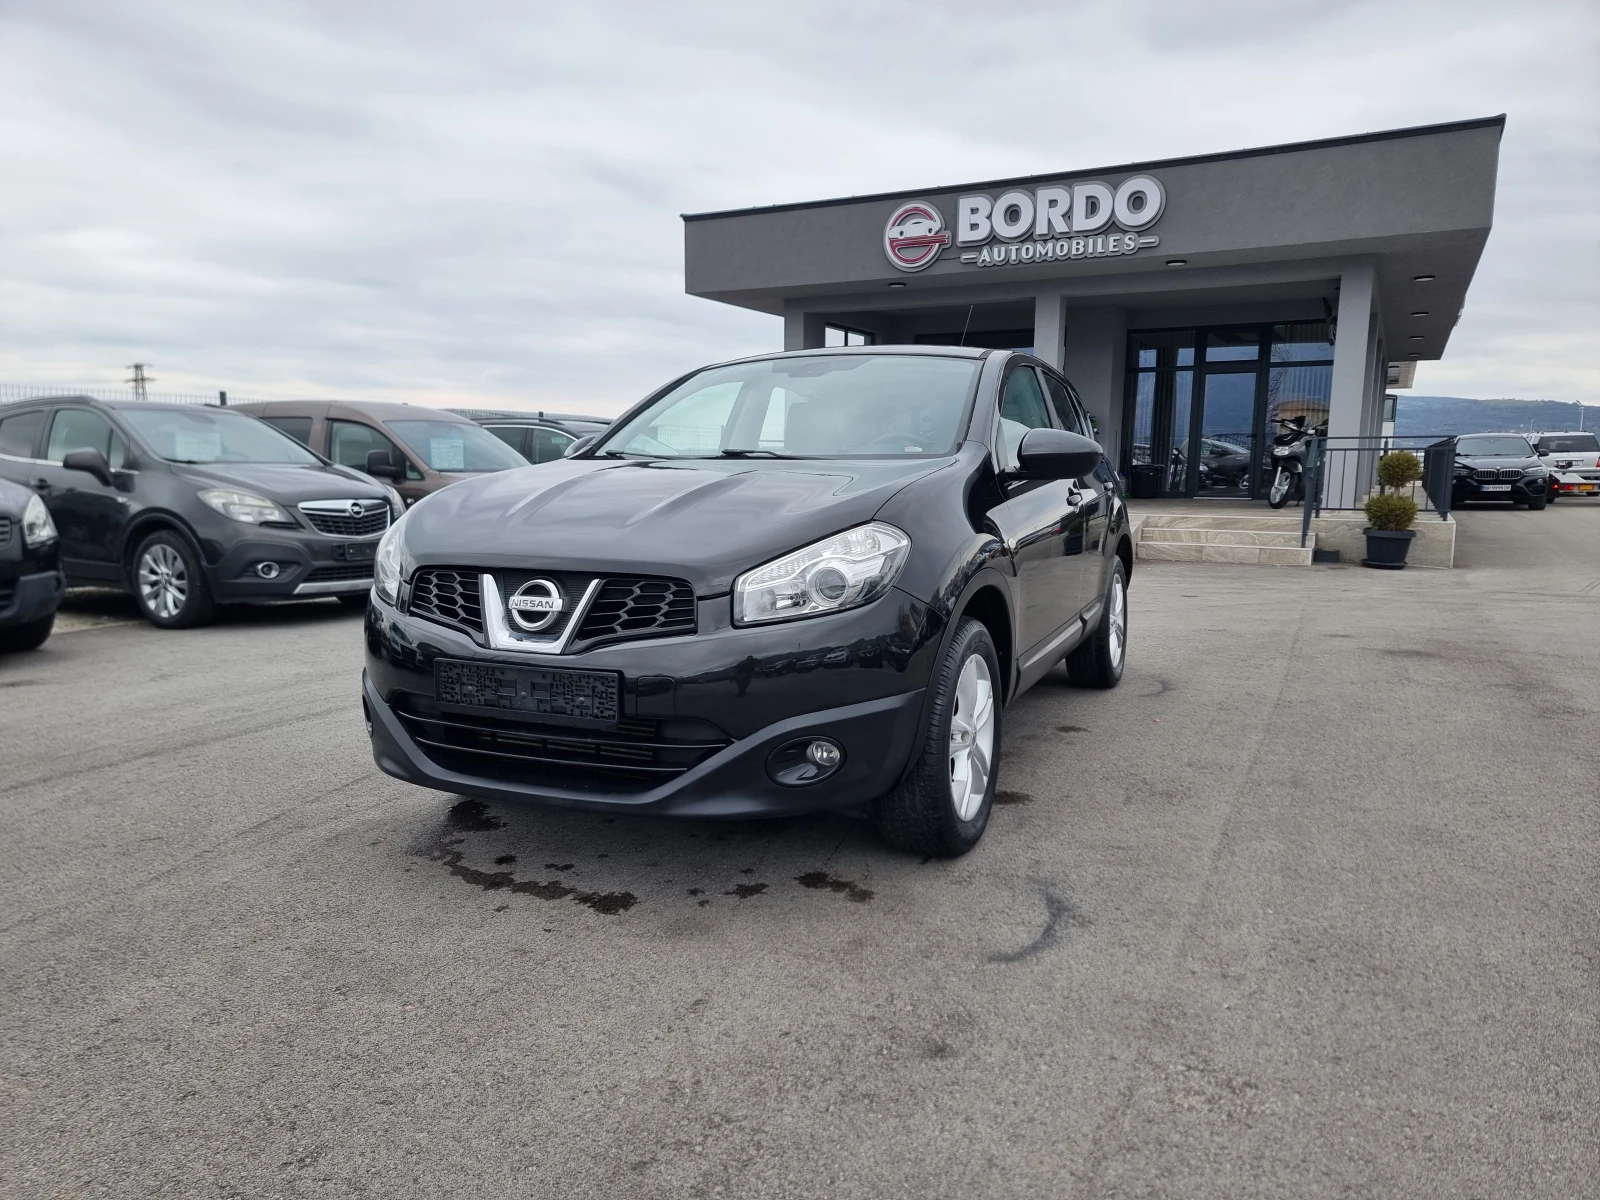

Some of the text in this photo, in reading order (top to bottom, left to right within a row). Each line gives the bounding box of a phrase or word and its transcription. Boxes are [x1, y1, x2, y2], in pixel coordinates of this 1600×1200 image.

[958, 177, 1162, 243] BORDO
[978, 234, 1136, 264] AUTOMOBILES
[511, 598, 554, 609] NISSAN
